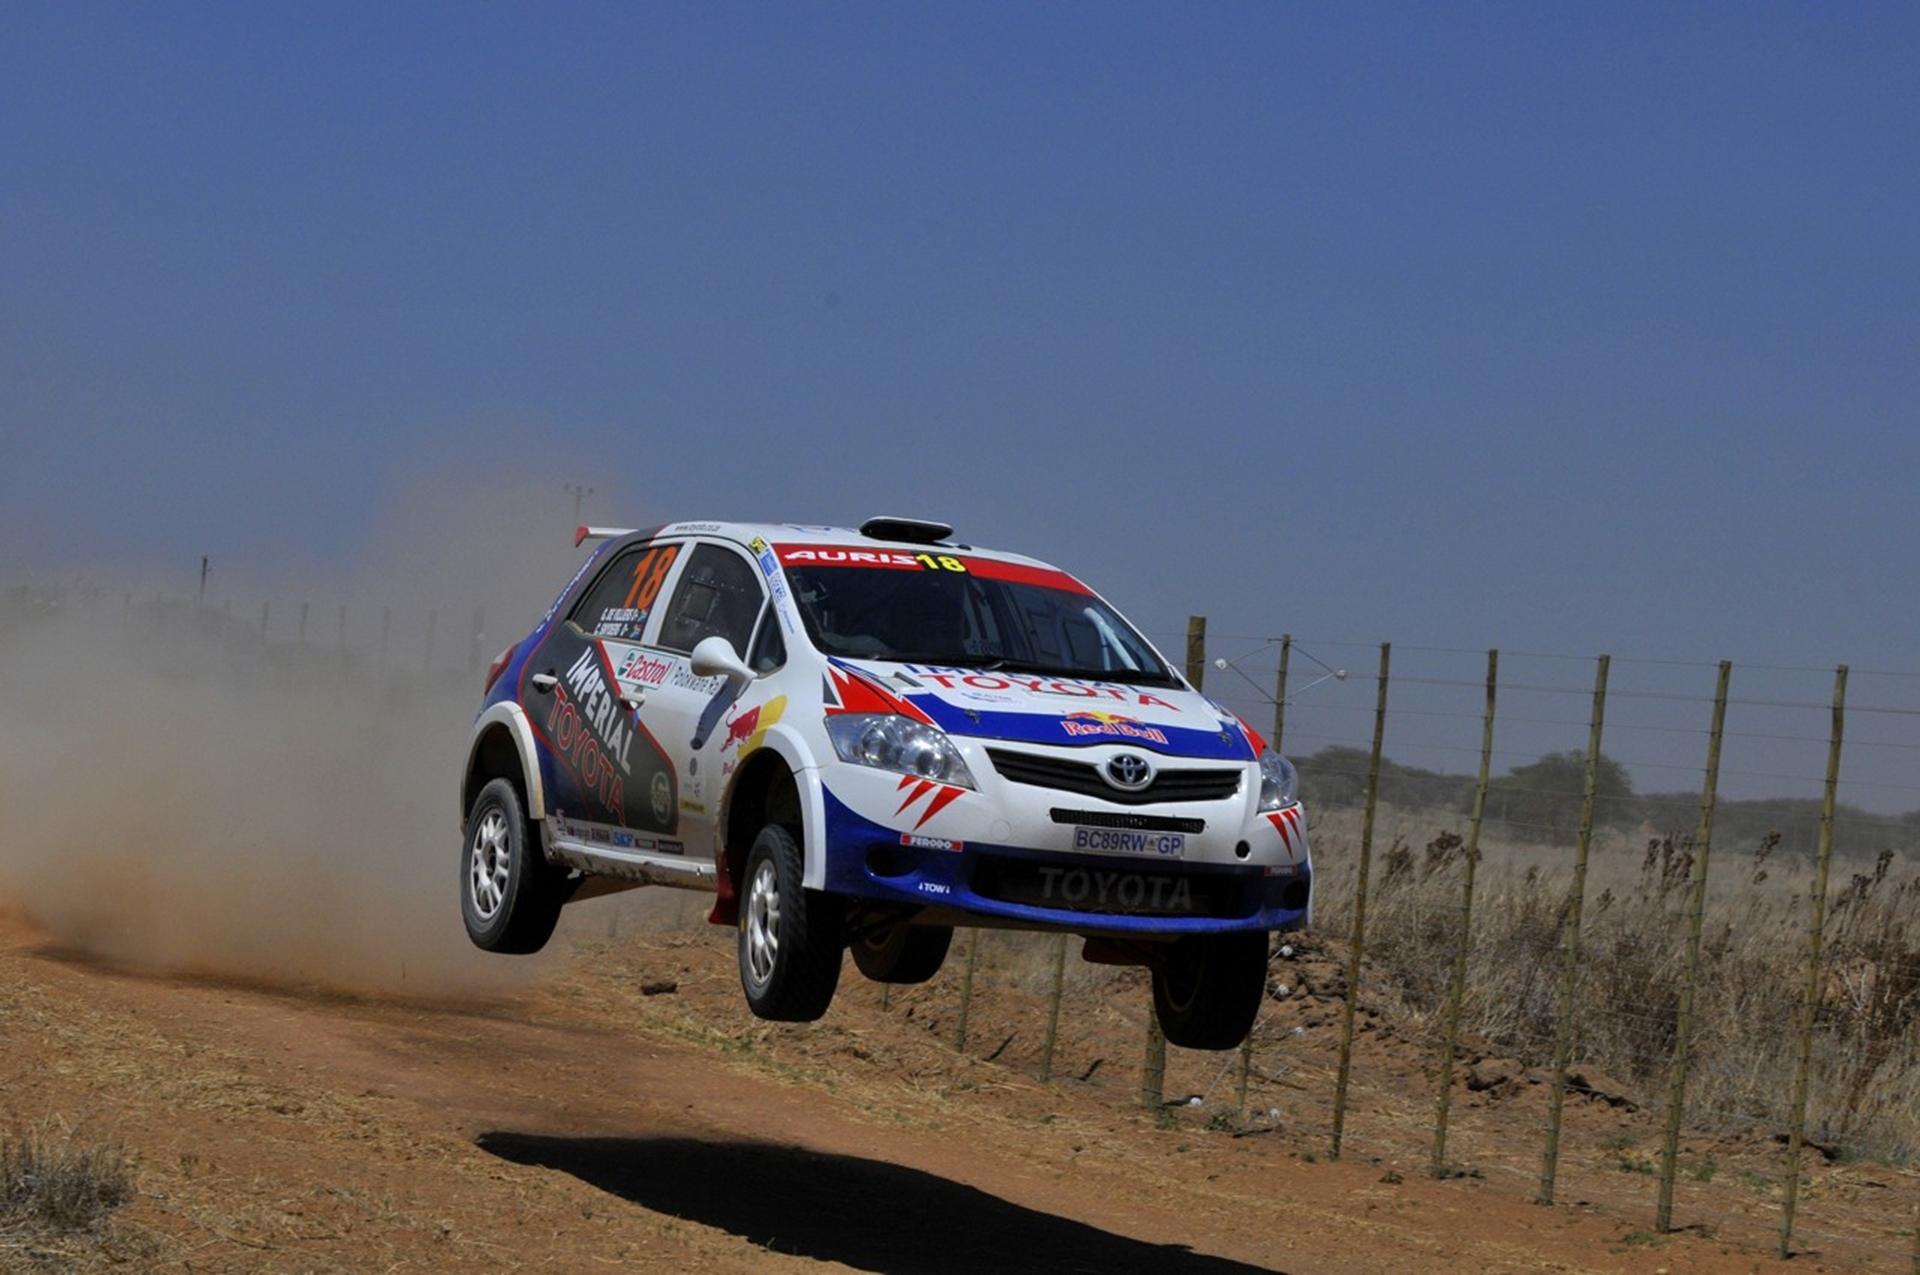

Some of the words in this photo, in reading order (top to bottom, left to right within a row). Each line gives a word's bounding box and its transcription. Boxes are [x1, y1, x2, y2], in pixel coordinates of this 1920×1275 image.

[785, 551, 918, 566] AURIS
[916, 554, 967, 573] 18
[623, 545, 678, 609] 18
[625, 654, 673, 685] Castrol
[917, 674, 1182, 712] TOYOTA
[566, 645, 633, 776] IMPERIAL
[1060, 720, 1119, 736] Red
[1112, 722, 1169, 745] Bull
[547, 682, 625, 828] TOYOTA
[1075, 829, 1147, 853] BC89RW
[1156, 836, 1182, 855] GP
[924, 882, 945, 894] TOW
[1038, 866, 1193, 911] TOYOTA
